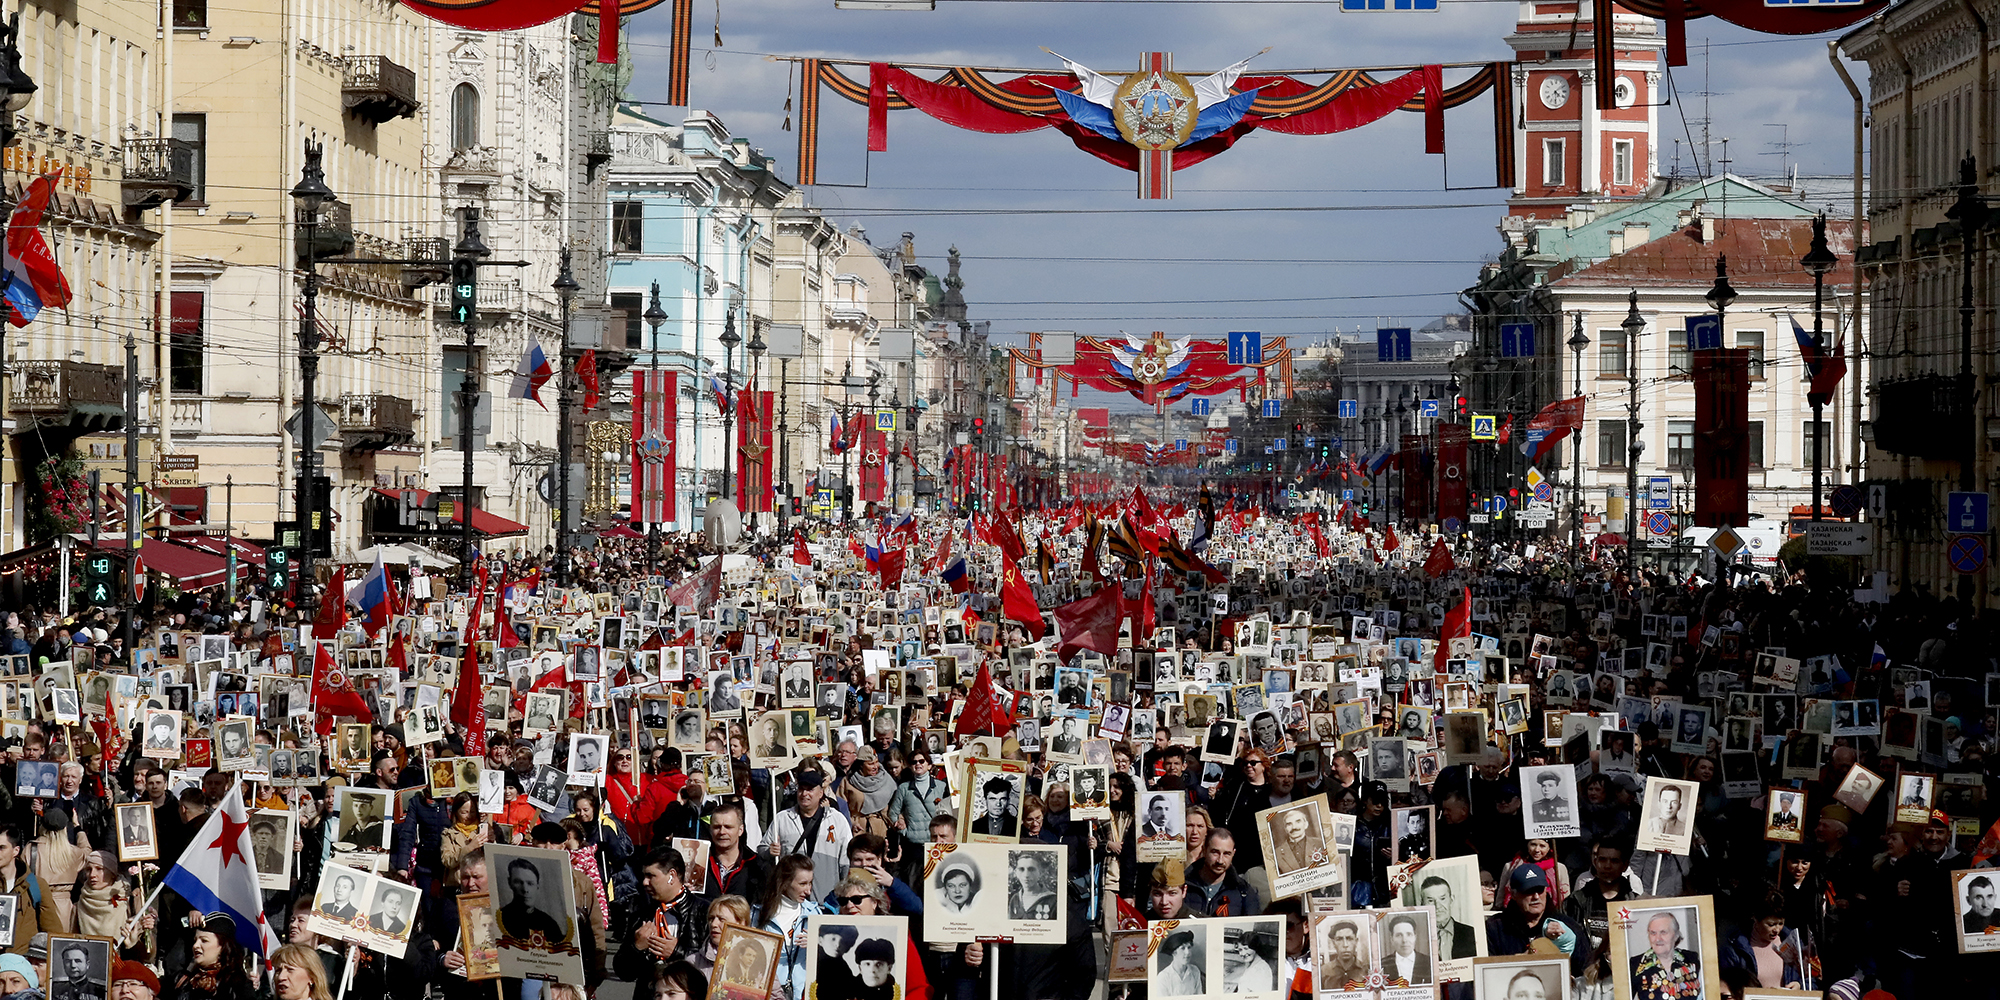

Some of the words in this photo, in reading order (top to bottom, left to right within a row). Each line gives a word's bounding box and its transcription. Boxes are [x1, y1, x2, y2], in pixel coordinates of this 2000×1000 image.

[457, 285, 472, 298] 48
[270, 551, 285, 563] 48
[92, 559, 108, 573] 48
[1291, 869, 1318, 881] ЗОБНИН
[1305, 870, 1336, 882] ОСИПОВИЧ
[1386, 989, 1428, 997] ГЕРАСИМЕНКО
